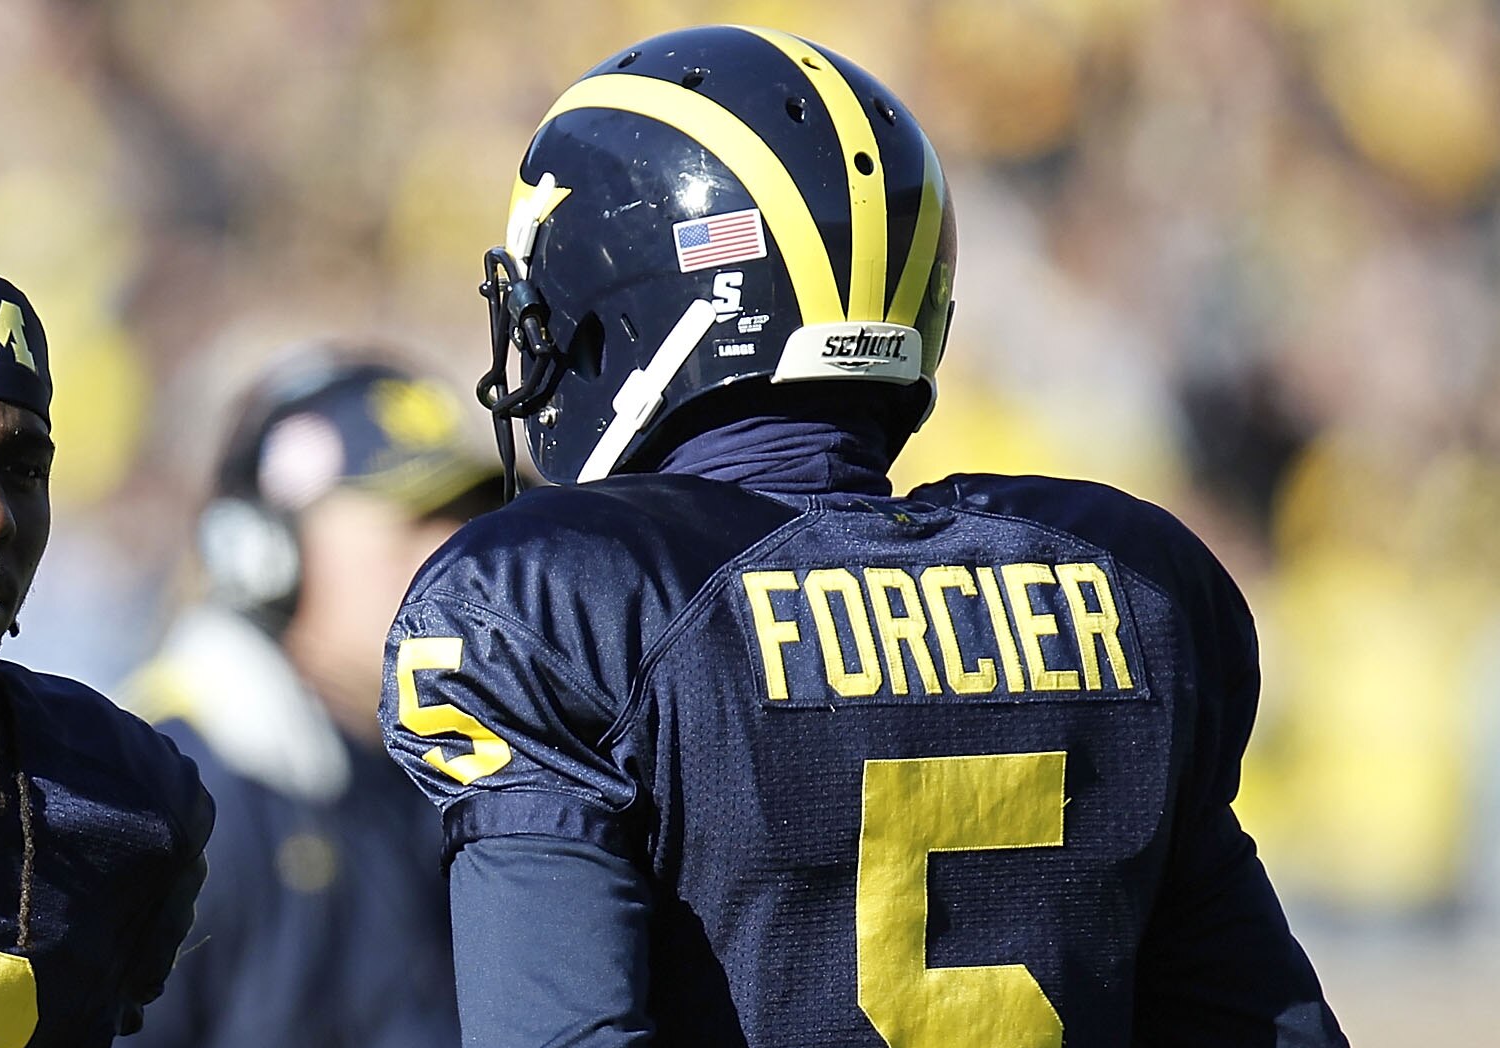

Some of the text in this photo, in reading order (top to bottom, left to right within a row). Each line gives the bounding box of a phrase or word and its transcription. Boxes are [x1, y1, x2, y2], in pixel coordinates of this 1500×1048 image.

[718, 343, 756, 357] LARGE
[822, 327, 905, 358] schutt
[741, 562, 1133, 700] FORCIER
[395, 638, 512, 786] 5
